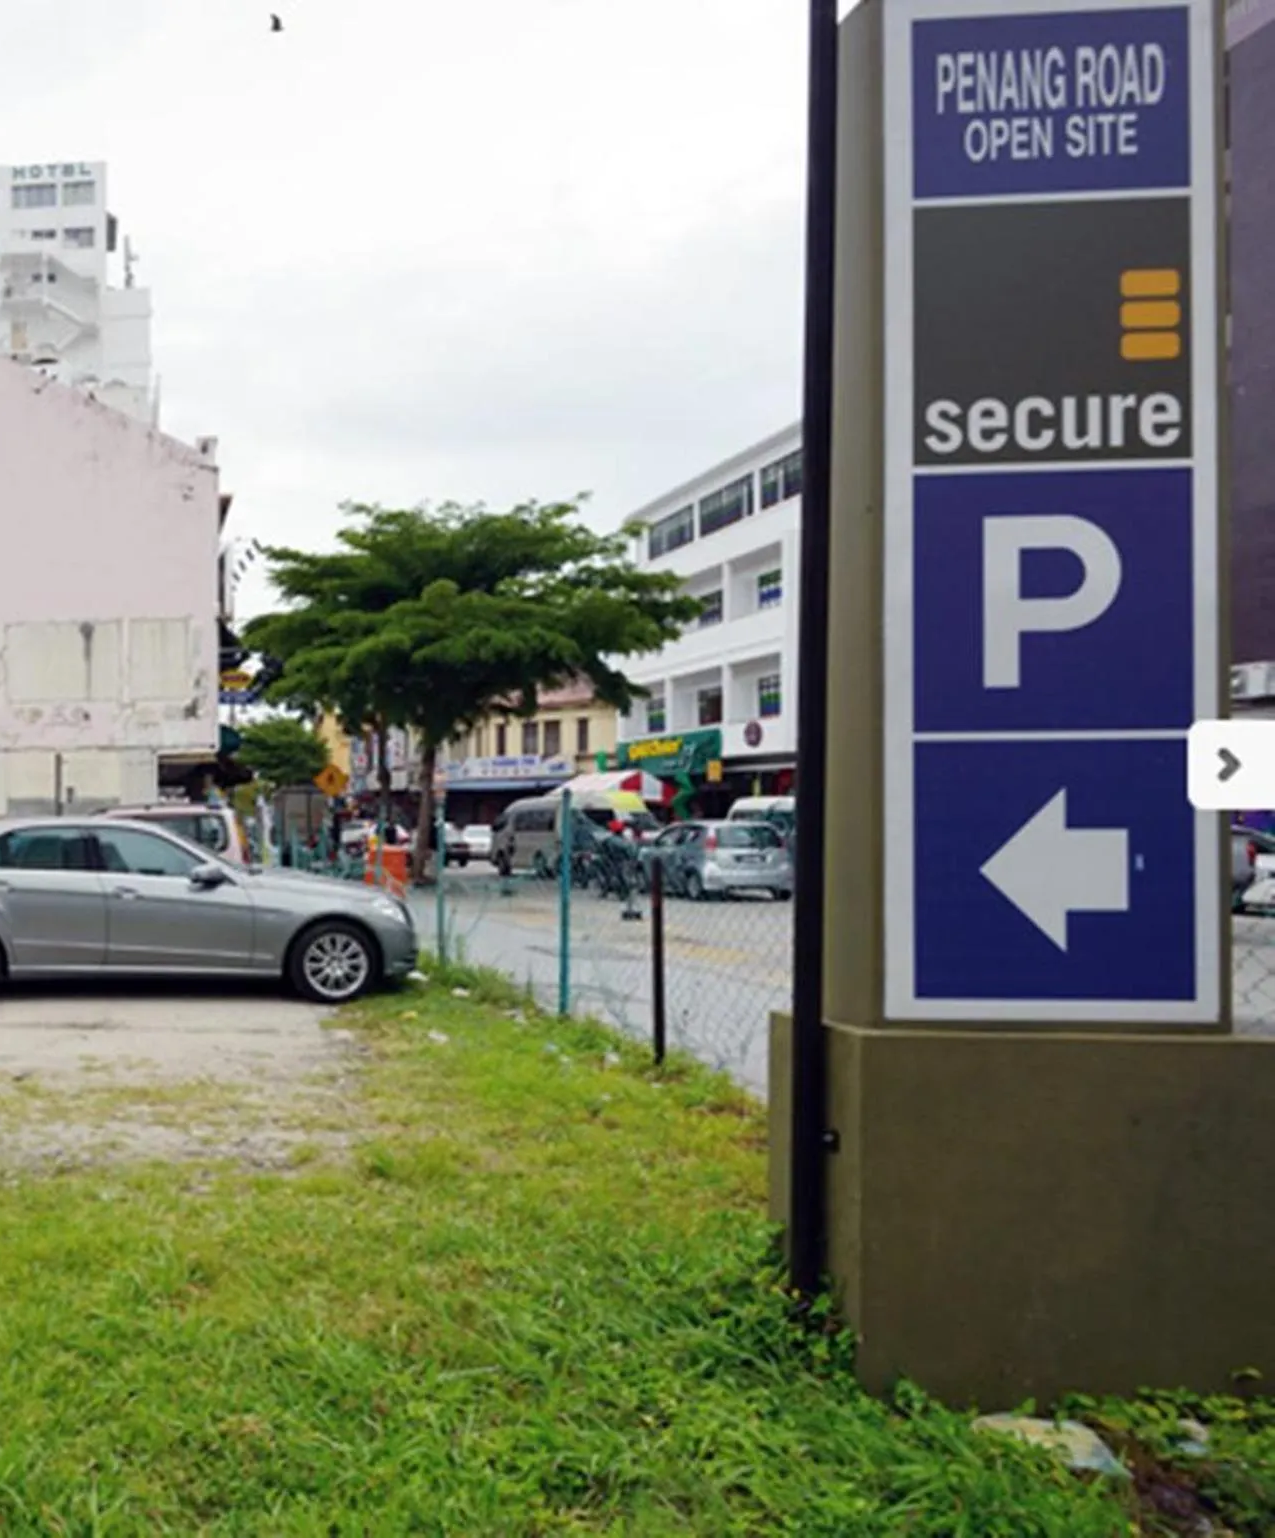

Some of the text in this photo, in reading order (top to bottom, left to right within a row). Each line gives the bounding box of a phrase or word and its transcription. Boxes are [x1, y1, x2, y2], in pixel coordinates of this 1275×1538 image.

[936, 43, 1165, 114] PENANG ROAD
[964, 113, 1138, 162] OPEN SITE
[12, 163, 91, 179] HOTEL
[924, 390, 1181, 454] secure
[983, 514, 1122, 688] P
